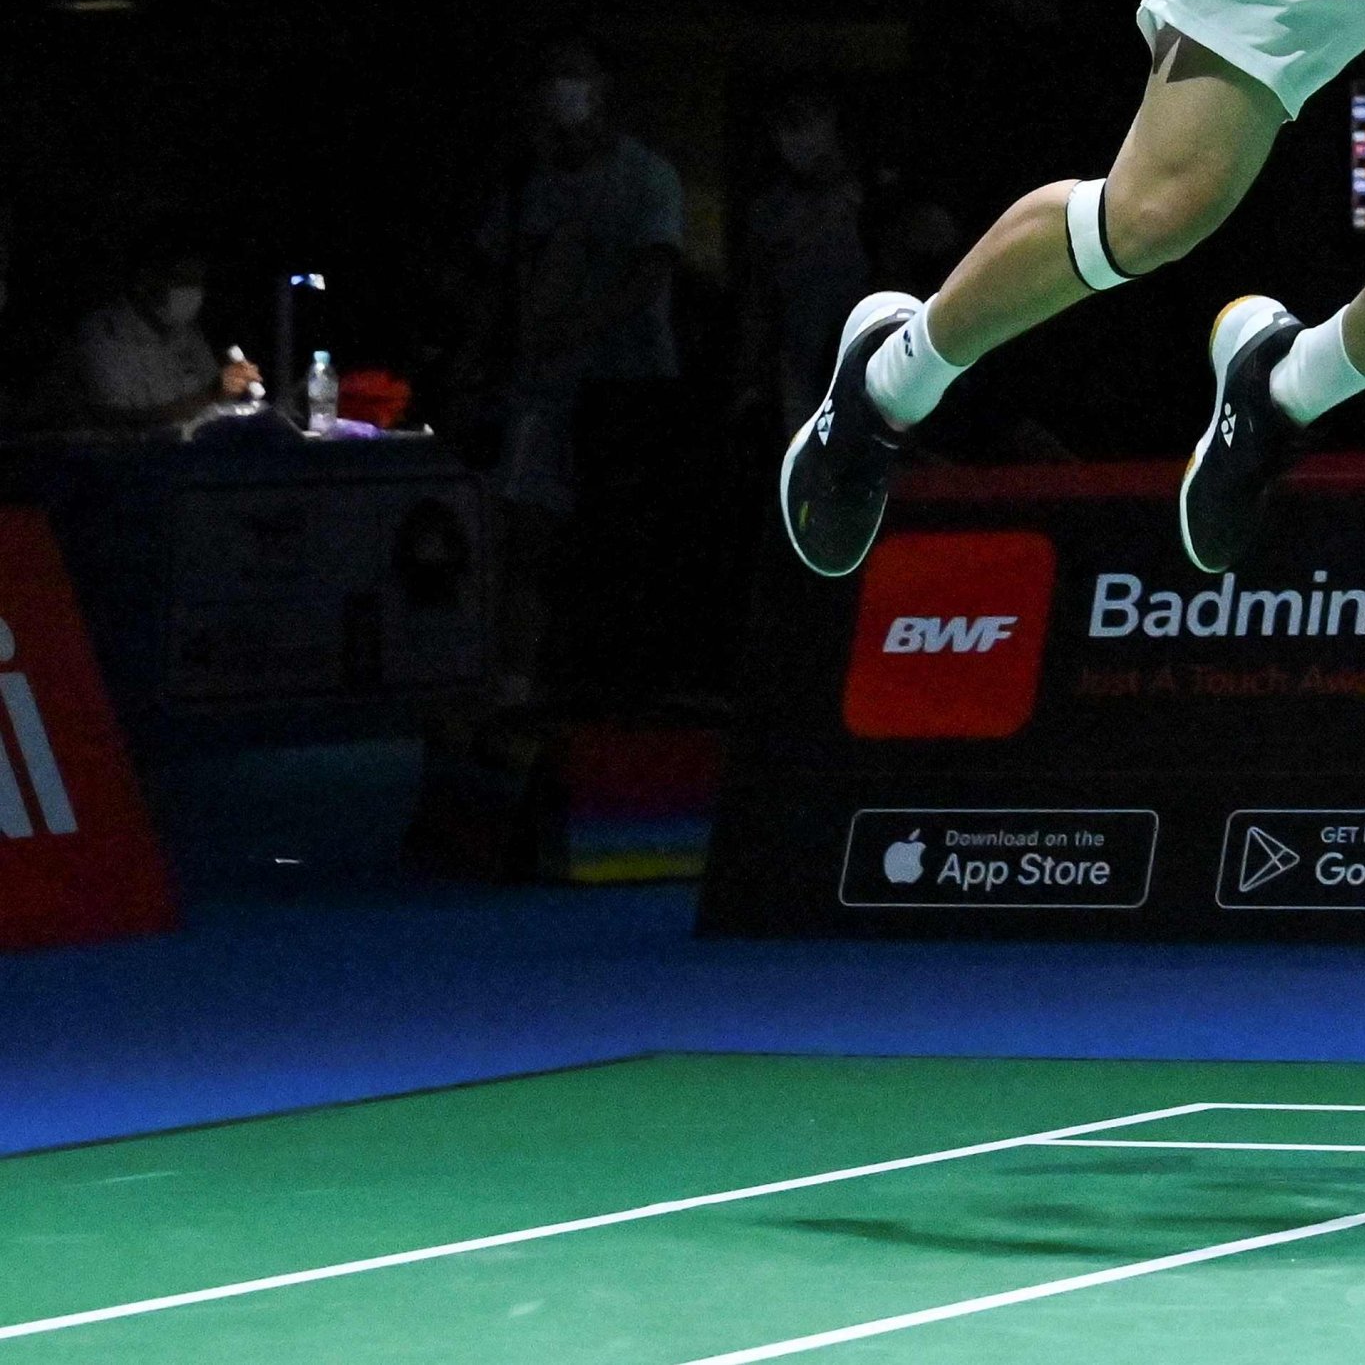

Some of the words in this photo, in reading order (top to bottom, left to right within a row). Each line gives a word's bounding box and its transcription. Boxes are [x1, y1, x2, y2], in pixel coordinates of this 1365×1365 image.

[882, 616, 1018, 654] BWF
[1075, 664, 1141, 697] Just
[1146, 664, 1178, 696] A
[1192, 664, 1290, 697] Touch
[945, 829, 1040, 847] Download
[1043, 833, 1068, 847] on
[1074, 830, 1106, 847] the
[1320, 826, 1360, 844] GET
[936, 852, 1010, 892] App
[1017, 852, 1111, 885] Store
